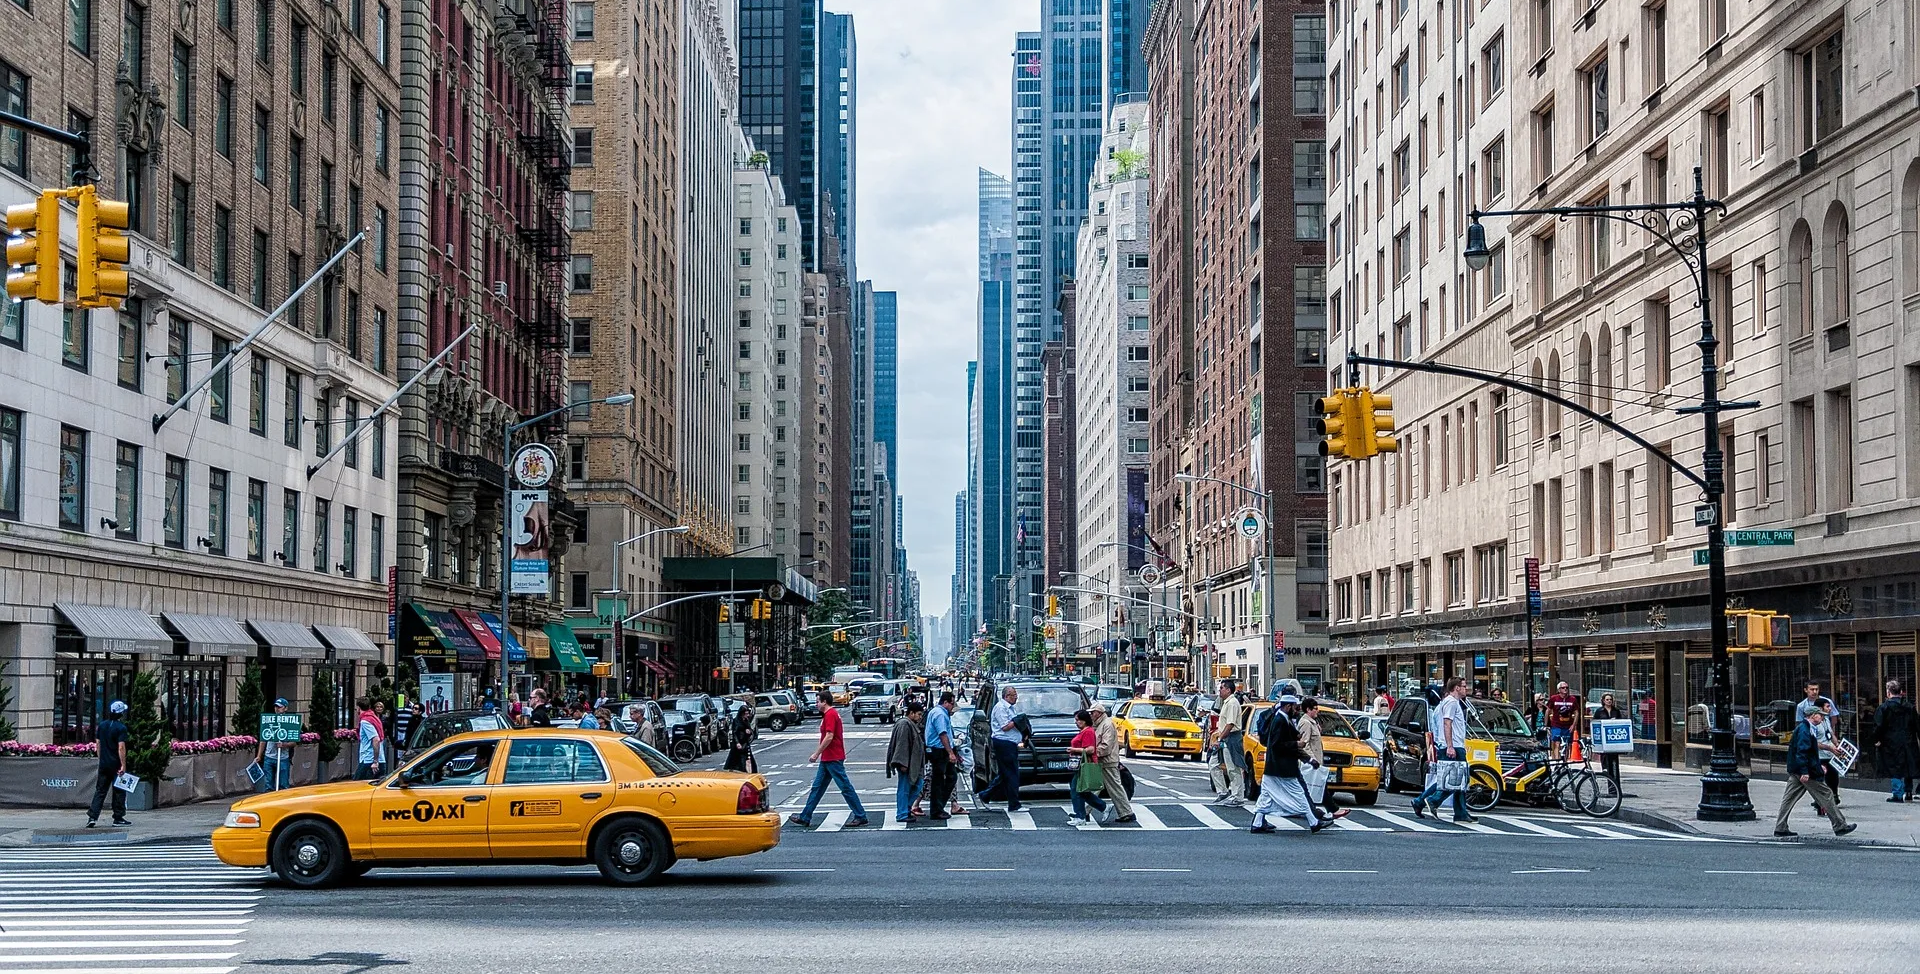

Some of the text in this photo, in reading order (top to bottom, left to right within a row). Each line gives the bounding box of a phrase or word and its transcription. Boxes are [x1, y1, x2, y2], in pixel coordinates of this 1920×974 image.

[521, 493, 539, 501] NYC
[1736, 531, 1793, 541] CENTRAL PARK
[113, 640, 136, 652] MARKET
[261, 715, 300, 724] BIKE RENTAL
[41, 778, 79, 788] MARKET
[382, 801, 465, 822] NYC TAXI
